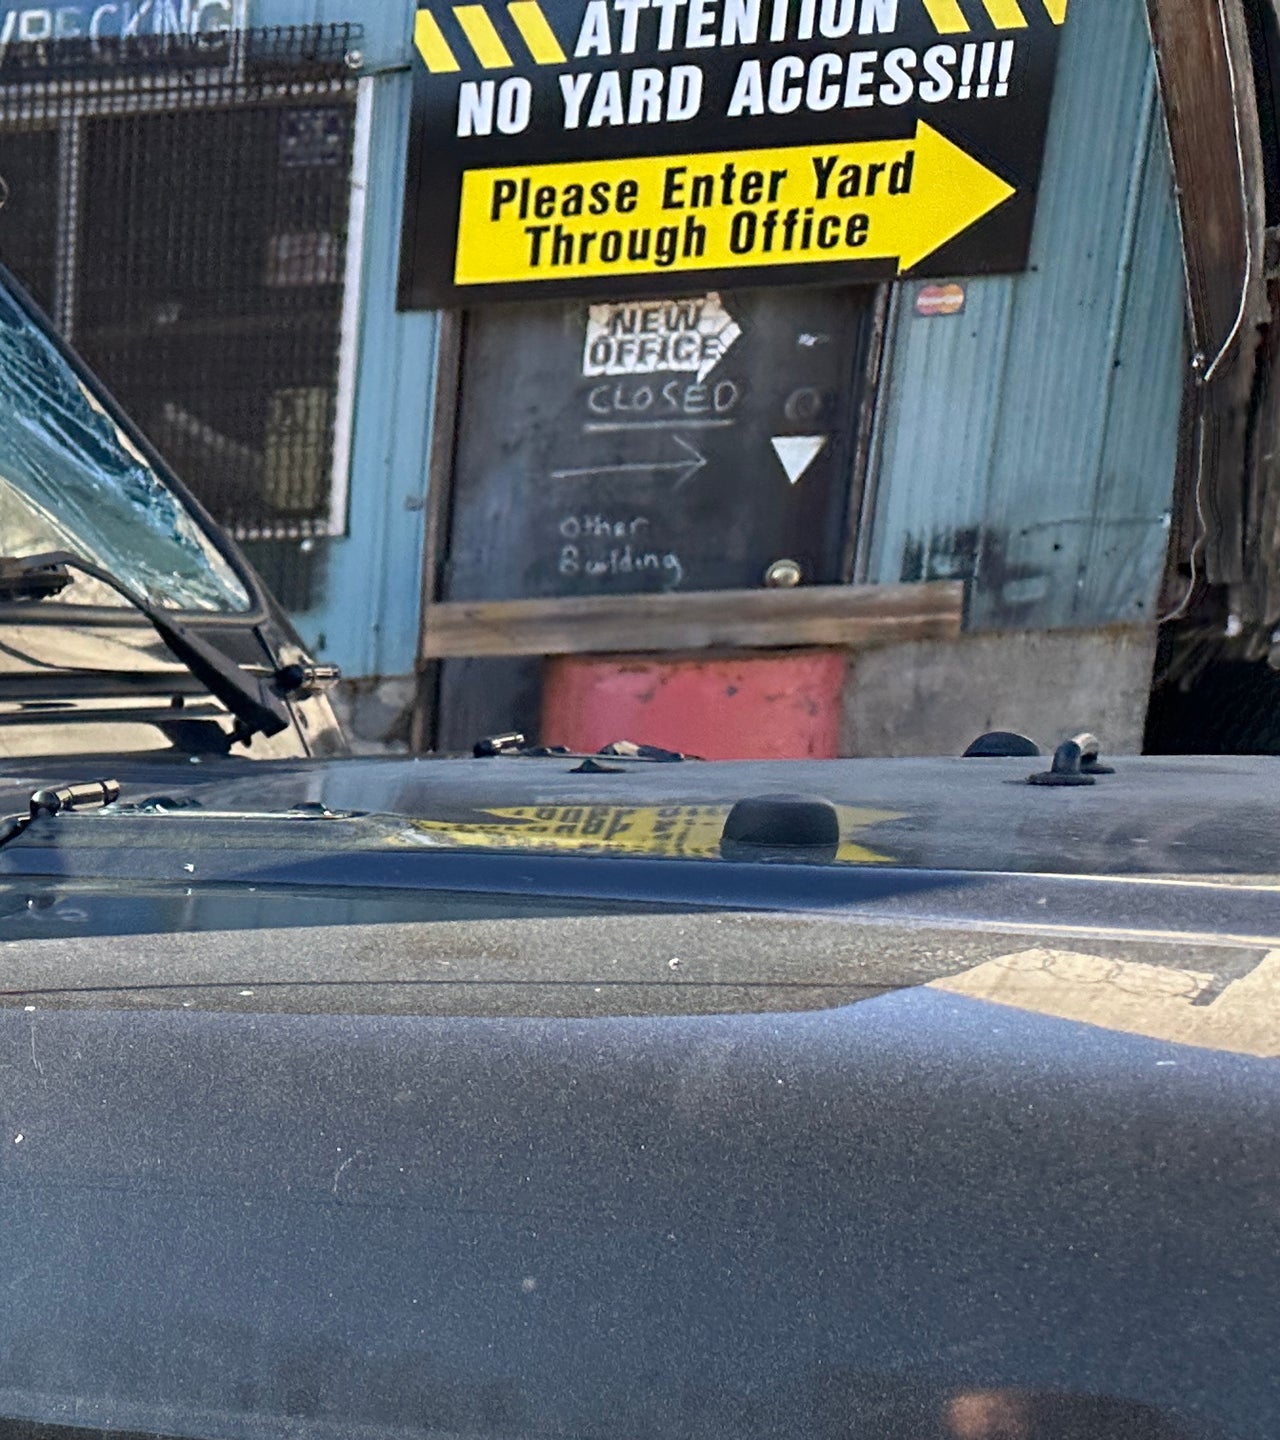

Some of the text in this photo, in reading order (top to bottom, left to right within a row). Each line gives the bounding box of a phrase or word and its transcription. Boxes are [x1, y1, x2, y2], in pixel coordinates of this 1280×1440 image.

[574, 0, 899, 58] ATTENTION
[457, 40, 1014, 138] NO YARD ACCESS!!!
[491, 150, 915, 222] Please Enter Yard
[524, 207, 870, 267] Through Office
[608, 303, 702, 334] NEW
[589, 332, 722, 366] OFFICE
[588, 379, 738, 413] CLOSED
[559, 514, 650, 539] Other
